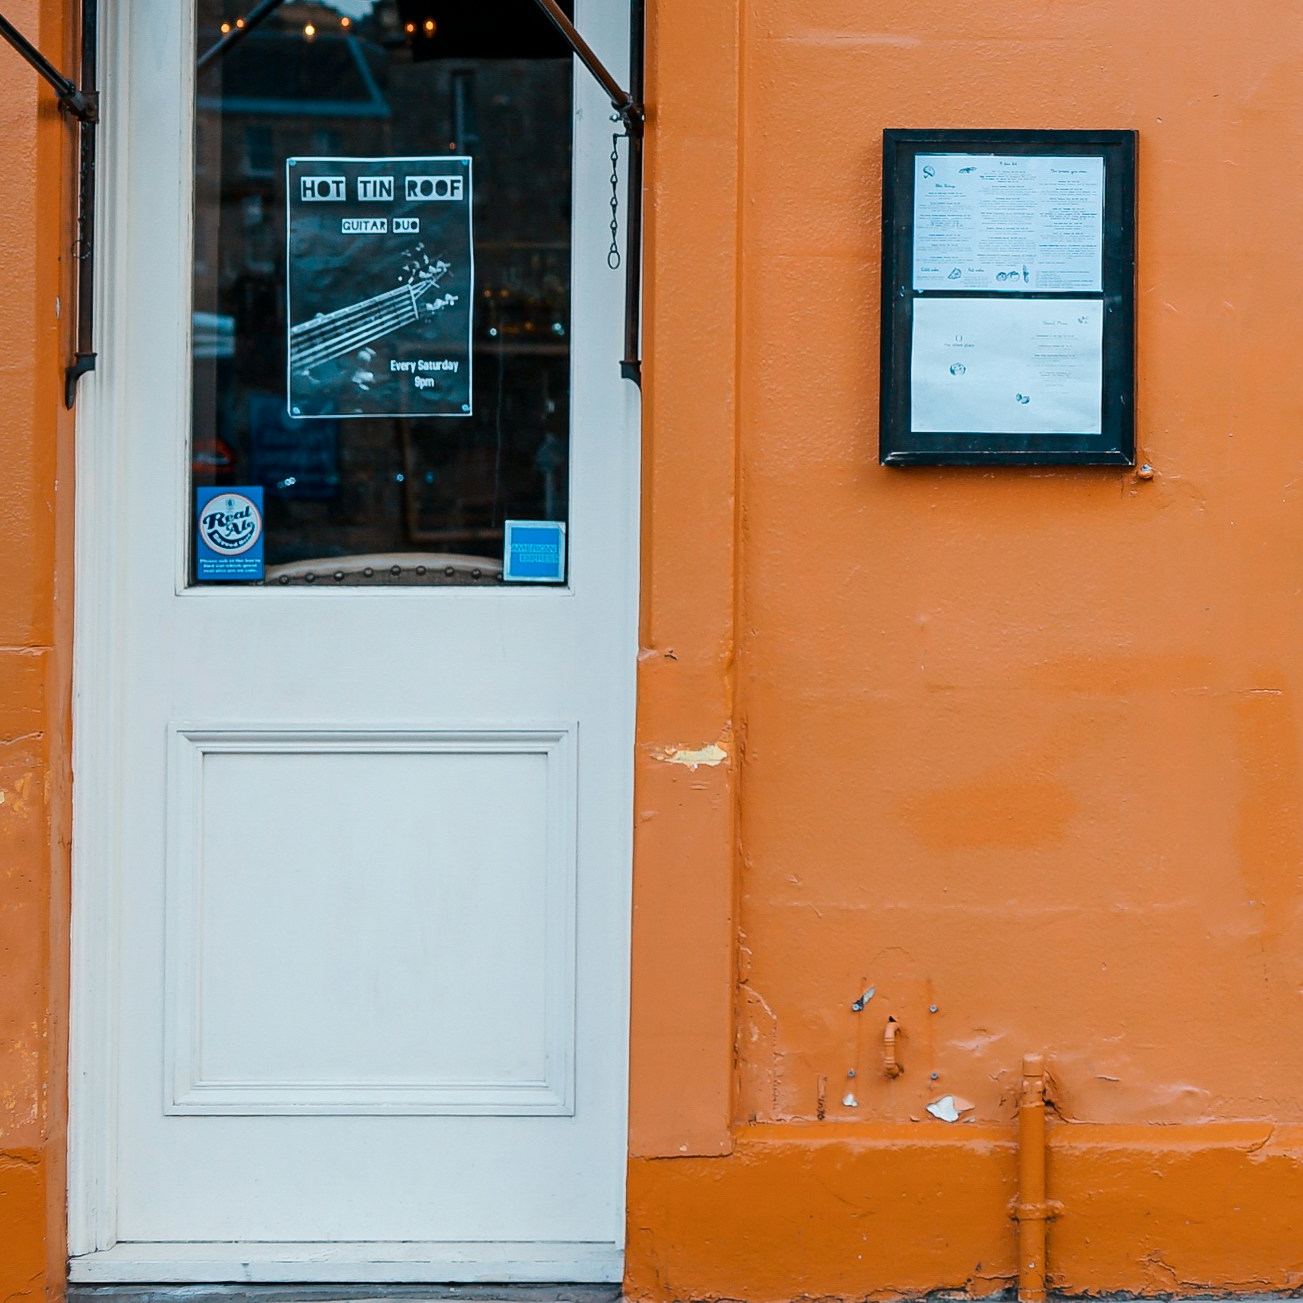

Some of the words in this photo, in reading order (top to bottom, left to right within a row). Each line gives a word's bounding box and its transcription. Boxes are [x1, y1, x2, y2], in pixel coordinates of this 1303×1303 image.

[302, 179, 344, 198] HOT
[359, 179, 393, 198] TIN
[407, 179, 461, 198] ROOF
[342, 220, 387, 232] GUITAR
[395, 219, 419, 232] DUO
[390, 360, 416, 373] Every
[418, 359, 459, 373] Saturday
[414, 376, 434, 390] 9pm
[203, 505, 251, 530] Real
[511, 543, 557, 553] AMERICAN
[519, 553, 559, 563] EXPRESS
